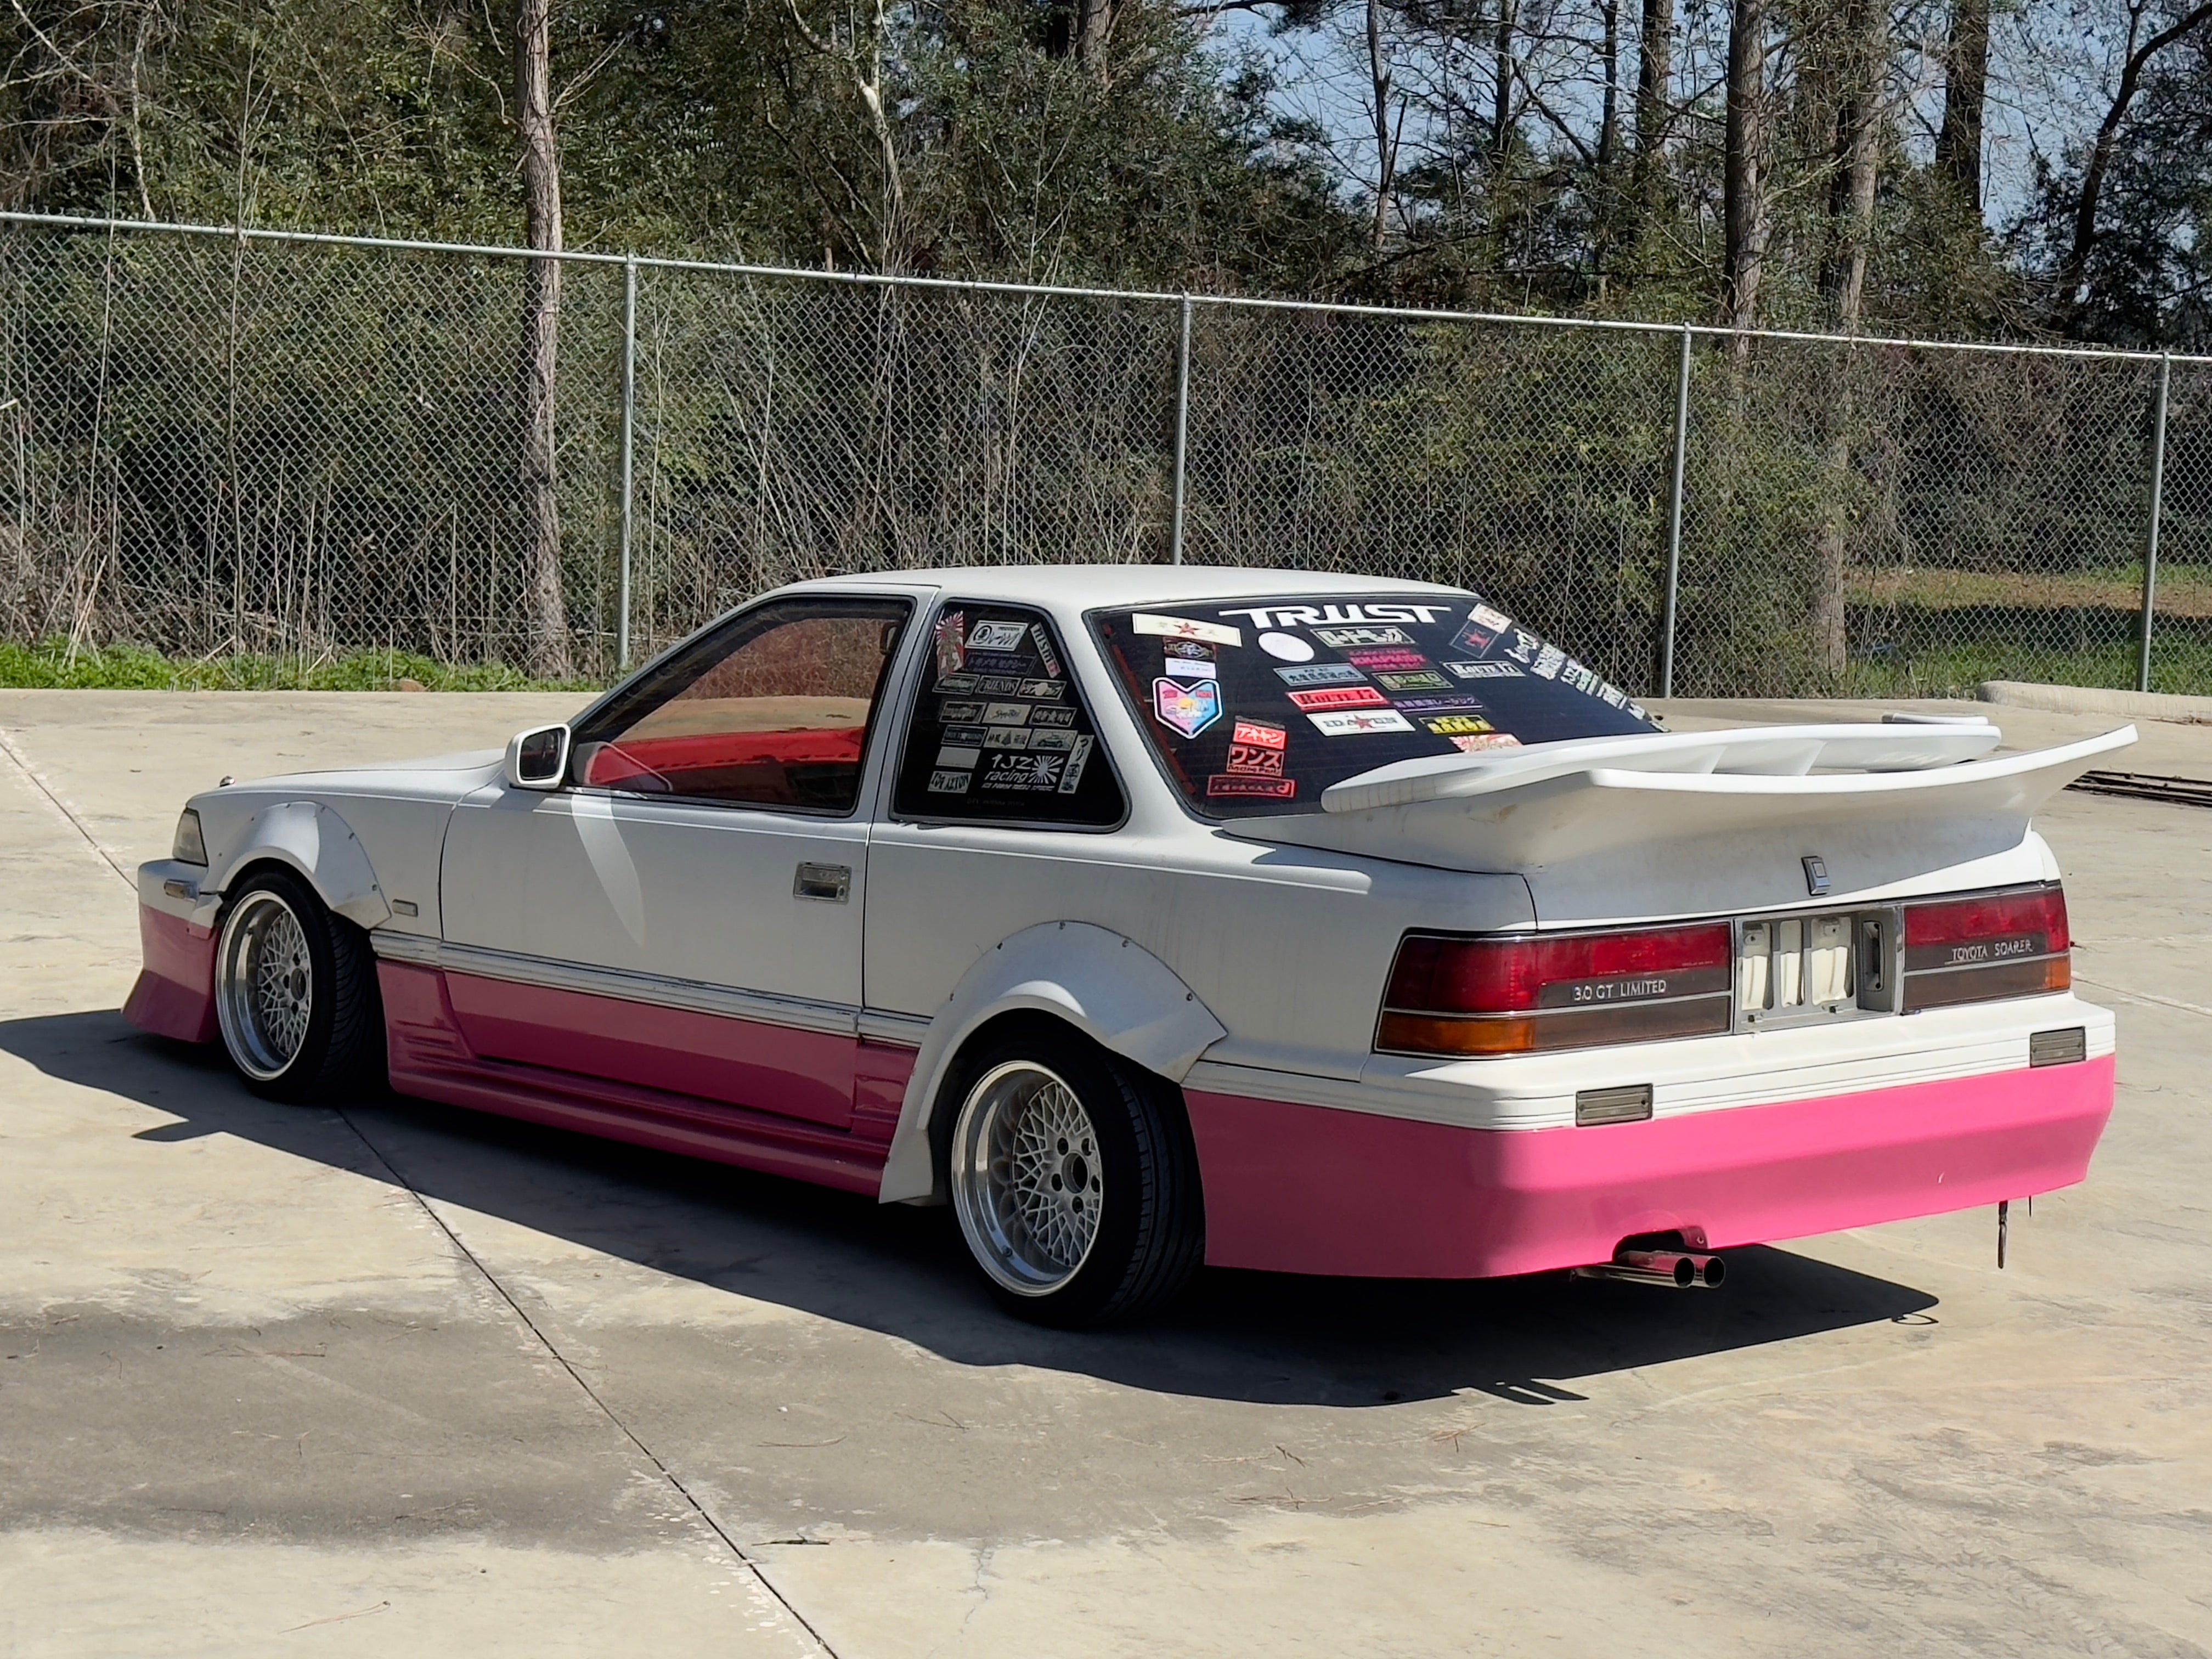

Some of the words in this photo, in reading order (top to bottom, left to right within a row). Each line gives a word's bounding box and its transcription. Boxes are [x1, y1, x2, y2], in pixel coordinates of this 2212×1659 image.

[1218, 604, 1452, 629] TRUST
[992, 754, 1034, 770] 1JZ
[1231, 746, 1280, 768] ワンス
[984, 769, 1029, 783] racing
[1951, 944, 1988, 961] TOYOTA
[1995, 939, 2033, 956] SOARER
[1596, 984, 1613, 998] GT
[1620, 980, 1667, 997] LIMITED
